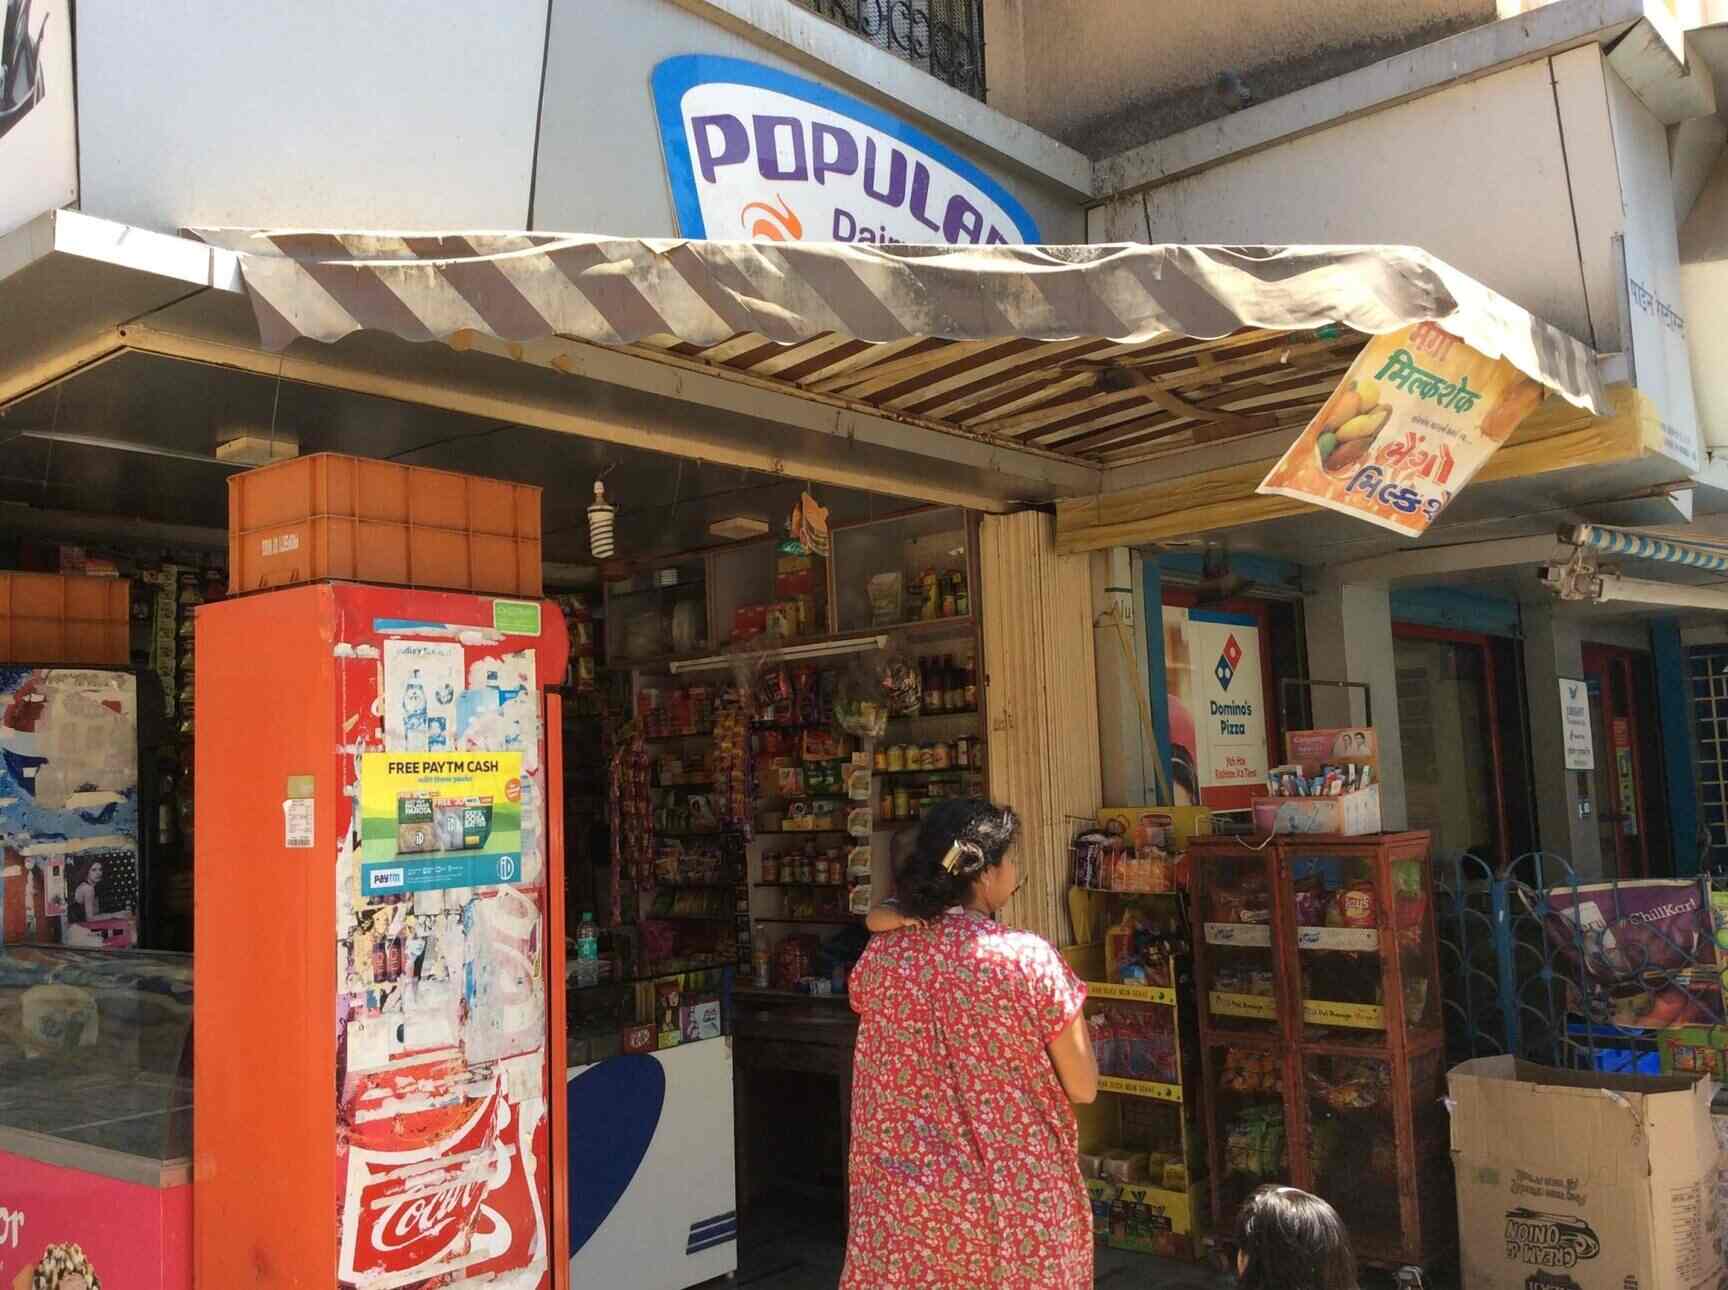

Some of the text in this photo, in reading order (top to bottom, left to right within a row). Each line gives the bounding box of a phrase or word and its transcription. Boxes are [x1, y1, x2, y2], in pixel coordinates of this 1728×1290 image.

[1210, 700, 1252, 716] Domino's
[1220, 719, 1245, 736] Pizza
[388, 760, 499, 774] FREE PAYTM CASH
[1505, 1220, 1559, 1245] ONION
[1523, 1244, 1576, 1268] CREAM
